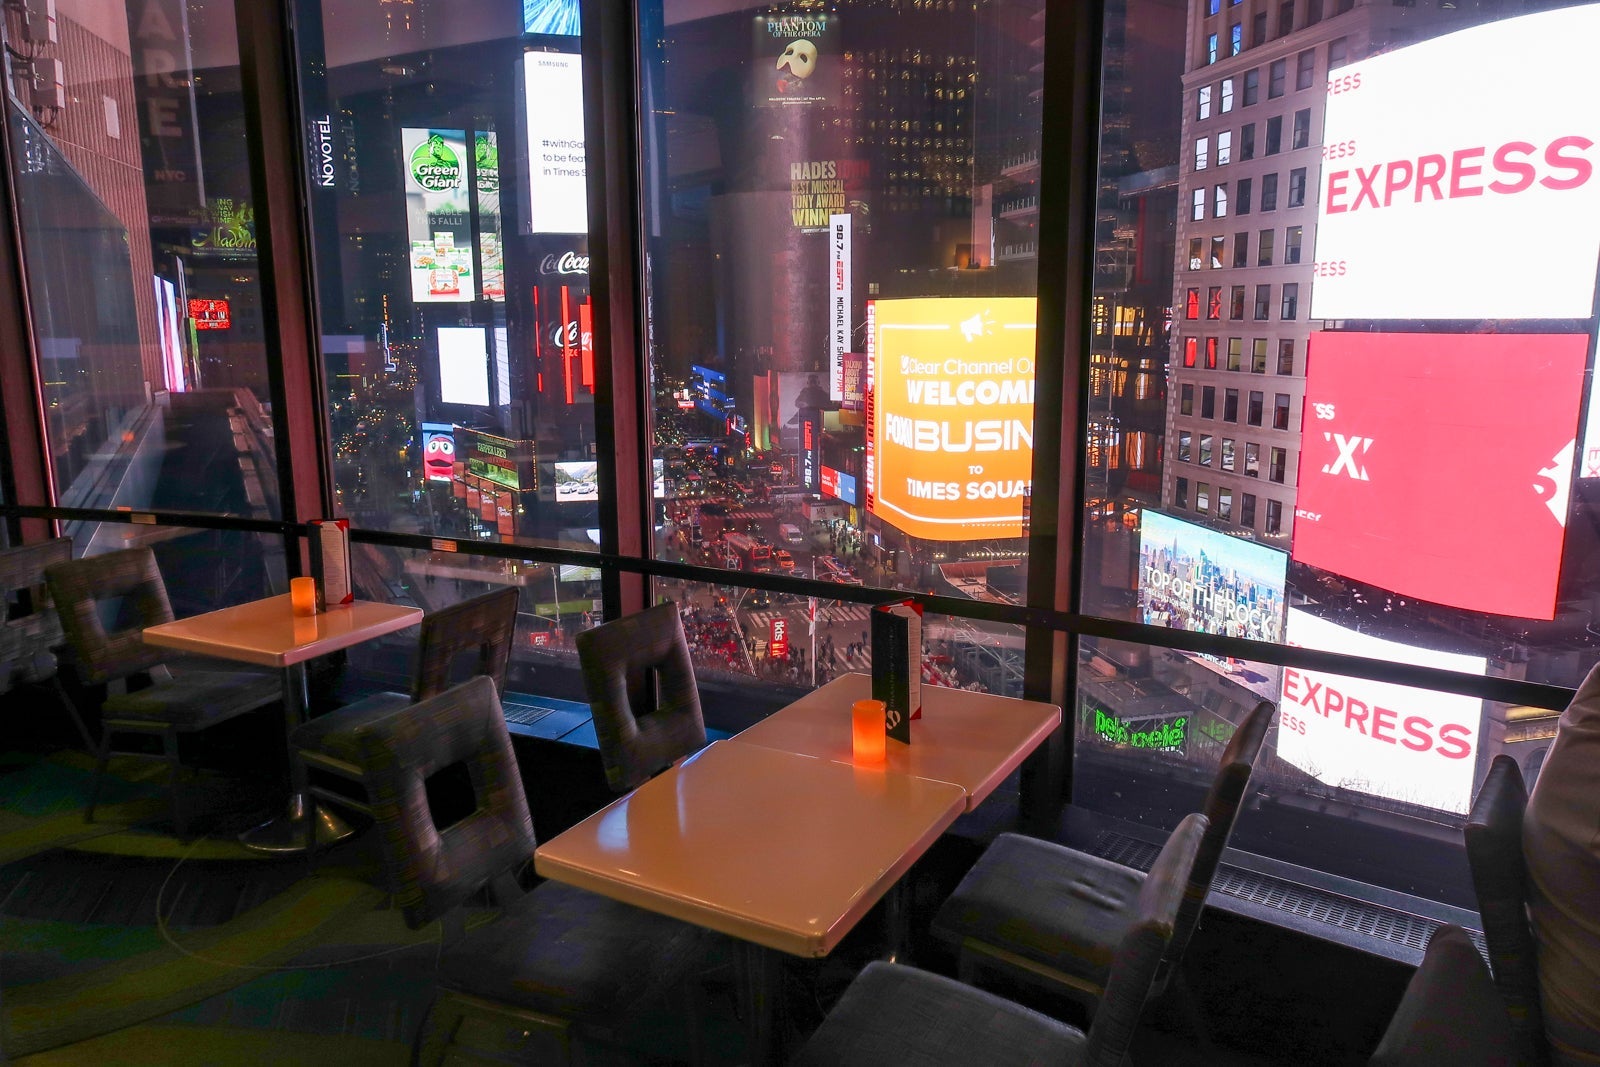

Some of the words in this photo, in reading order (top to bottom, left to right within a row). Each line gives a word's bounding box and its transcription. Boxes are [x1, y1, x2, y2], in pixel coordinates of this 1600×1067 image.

[767, 21, 826, 32] PHANTOM
[538, 60, 569, 68] SAMSUNG
[317, 114, 334, 186] NOVOTEL
[543, 153, 552, 161] to
[554, 153, 566, 161] be
[416, 164, 459, 176] Green
[543, 167, 551, 175] in
[553, 167, 580, 176] Times
[1326, 136, 1595, 215] EXPRESS
[421, 175, 461, 188] Giant
[791, 180, 810, 194] BEST
[812, 179, 845, 194] MUSICAL
[792, 194, 814, 208] TONY
[816, 193, 845, 208] AWARD
[439, 217, 462, 225] FALL!
[557, 251, 589, 274] Coca
[836, 261, 844, 291] ESPN
[836, 297, 844, 328] MICHAEL
[836, 330, 844, 344] KAY
[836, 346, 844, 367] SHOW
[943, 357, 1013, 375] Channel
[804, 421, 812, 450] ESPN
[866, 455, 875, 492] VISIT
[968, 465, 984, 475] TO
[907, 478, 960, 500] TIMES
[1145, 565, 1170, 590] TOP
[1172, 577, 1193, 600] OF
[1193, 584, 1225, 615] THE
[1225, 598, 1273, 637] ROCK
[775, 620, 784, 641] tkts
[1283, 667, 1472, 760] EXPRESS
